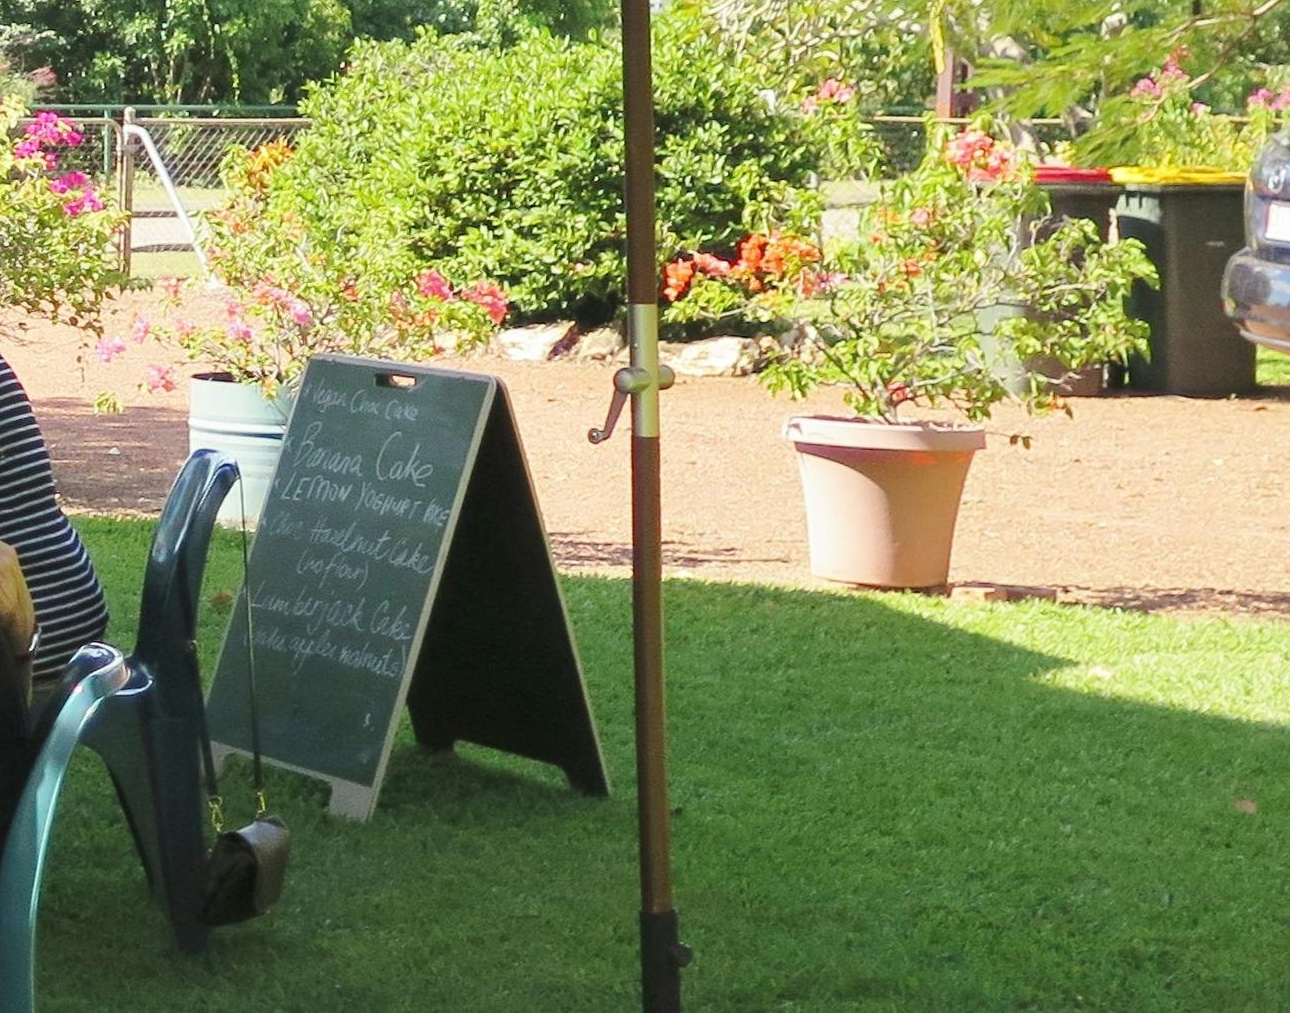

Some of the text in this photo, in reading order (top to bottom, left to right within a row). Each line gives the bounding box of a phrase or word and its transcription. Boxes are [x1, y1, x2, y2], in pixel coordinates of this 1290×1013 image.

[385, 399, 419, 421] Cake
[292, 420, 435, 488] Banana Cake
[388, 537, 435, 574] Cake
